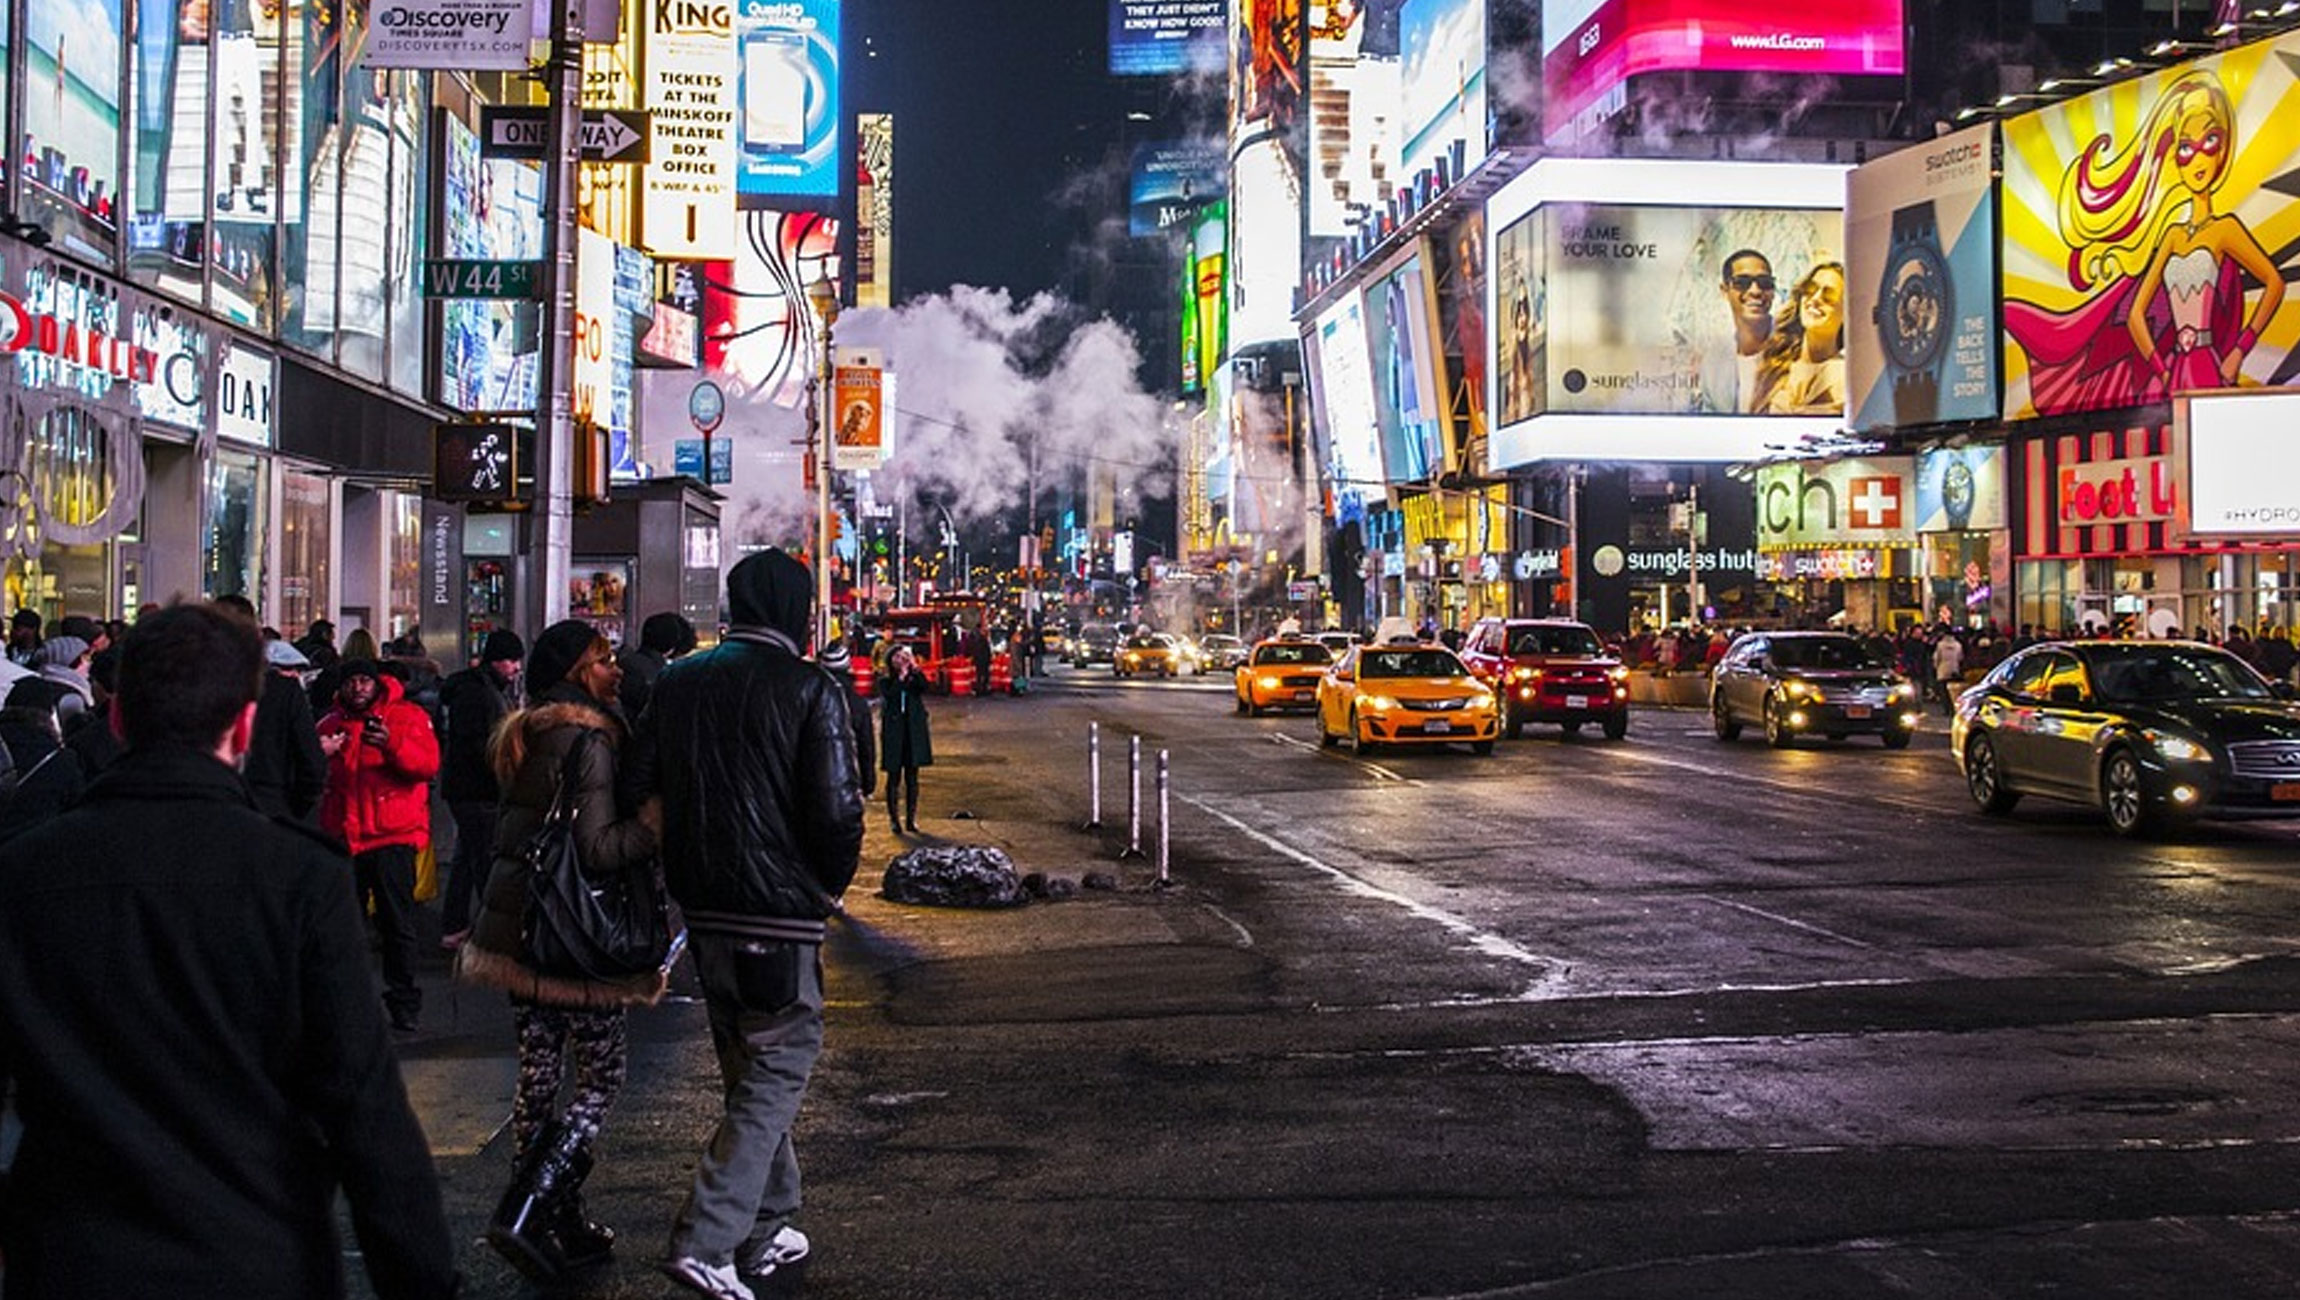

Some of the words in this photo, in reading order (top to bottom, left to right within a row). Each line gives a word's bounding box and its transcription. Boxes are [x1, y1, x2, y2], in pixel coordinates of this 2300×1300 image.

[655, 0, 731, 33] KING
[1126, 5, 1155, 16] THEY
[1156, 4, 1181, 15] JUST
[1183, 3, 1220, 14] DIDN'T
[390, 7, 511, 33] Discovery
[1124, 18, 1159, 29] KNOW
[1160, 17, 1188, 28] HOW
[390, 29, 419, 38] TIMES
[422, 29, 464, 38] SQUARE
[659, 72, 723, 87] TICKETS
[664, 90, 683, 103] AT
[689, 92, 717, 105] THE
[649, 107, 733, 123] MINSKOFF
[505, 123, 549, 144] ONE
[656, 124, 725, 141] THEATRE
[672, 143, 708, 157] BOX
[662, 160, 717, 175] OFFICE
[1561, 226, 1620, 240] FRAME
[1561, 244, 1609, 259] YOUR
[1613, 244, 1657, 259] LOVE
[431, 264, 459, 293] W
[465, 265, 504, 295] 44
[510, 266, 526, 282] St
[1963, 316, 1985, 331] THE
[1957, 333, 1985, 349] BACK
[38, 314, 159, 386] OAKLEY
[1956, 349, 1985, 365] TELLS
[1965, 365, 1985, 380] THE
[1953, 380, 1987, 398] STORY
[2061, 467, 2142, 522] Foot
[435, 515, 450, 604] Newsstand
[1627, 548, 1716, 577] sunglass
[1719, 548, 1754, 570] hut
[1795, 555, 1861, 575] swatch
